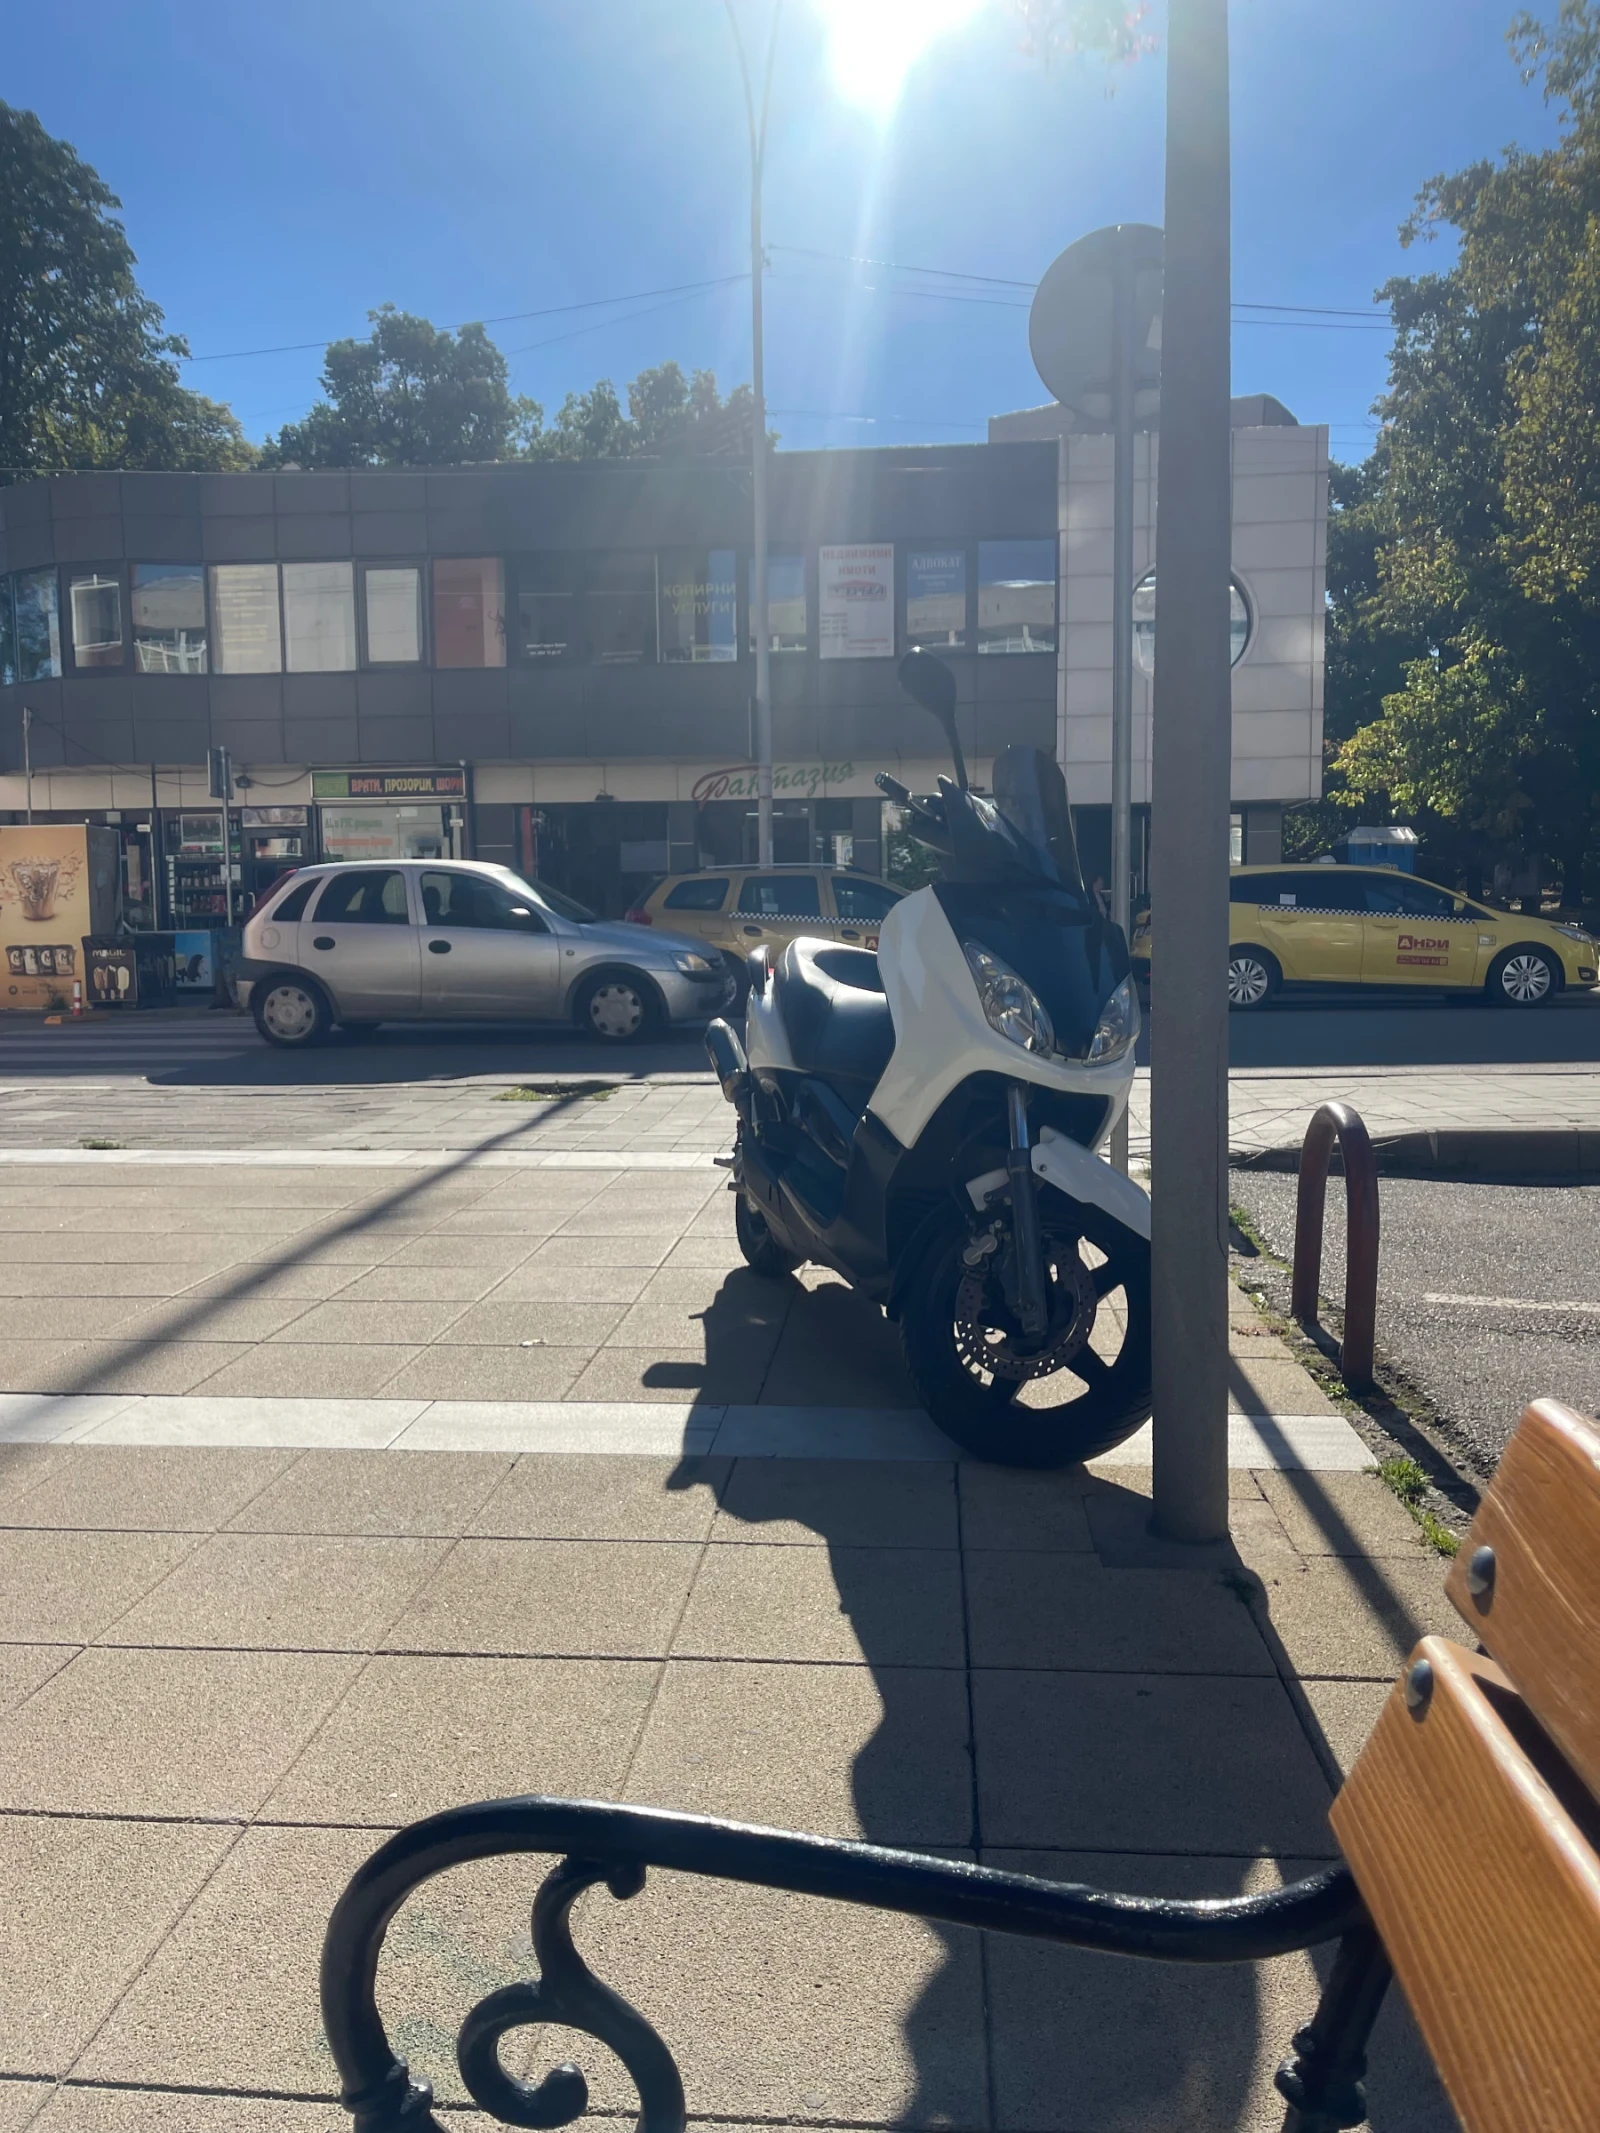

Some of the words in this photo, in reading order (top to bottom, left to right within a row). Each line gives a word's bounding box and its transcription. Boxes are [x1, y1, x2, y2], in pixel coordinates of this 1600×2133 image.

[911, 556, 962, 570] АДВОКАТ
[838, 565, 876, 576] ИМОТИ
[663, 583, 736, 598] КОПИРНИ
[672, 601, 729, 615] УСЛУГИ
